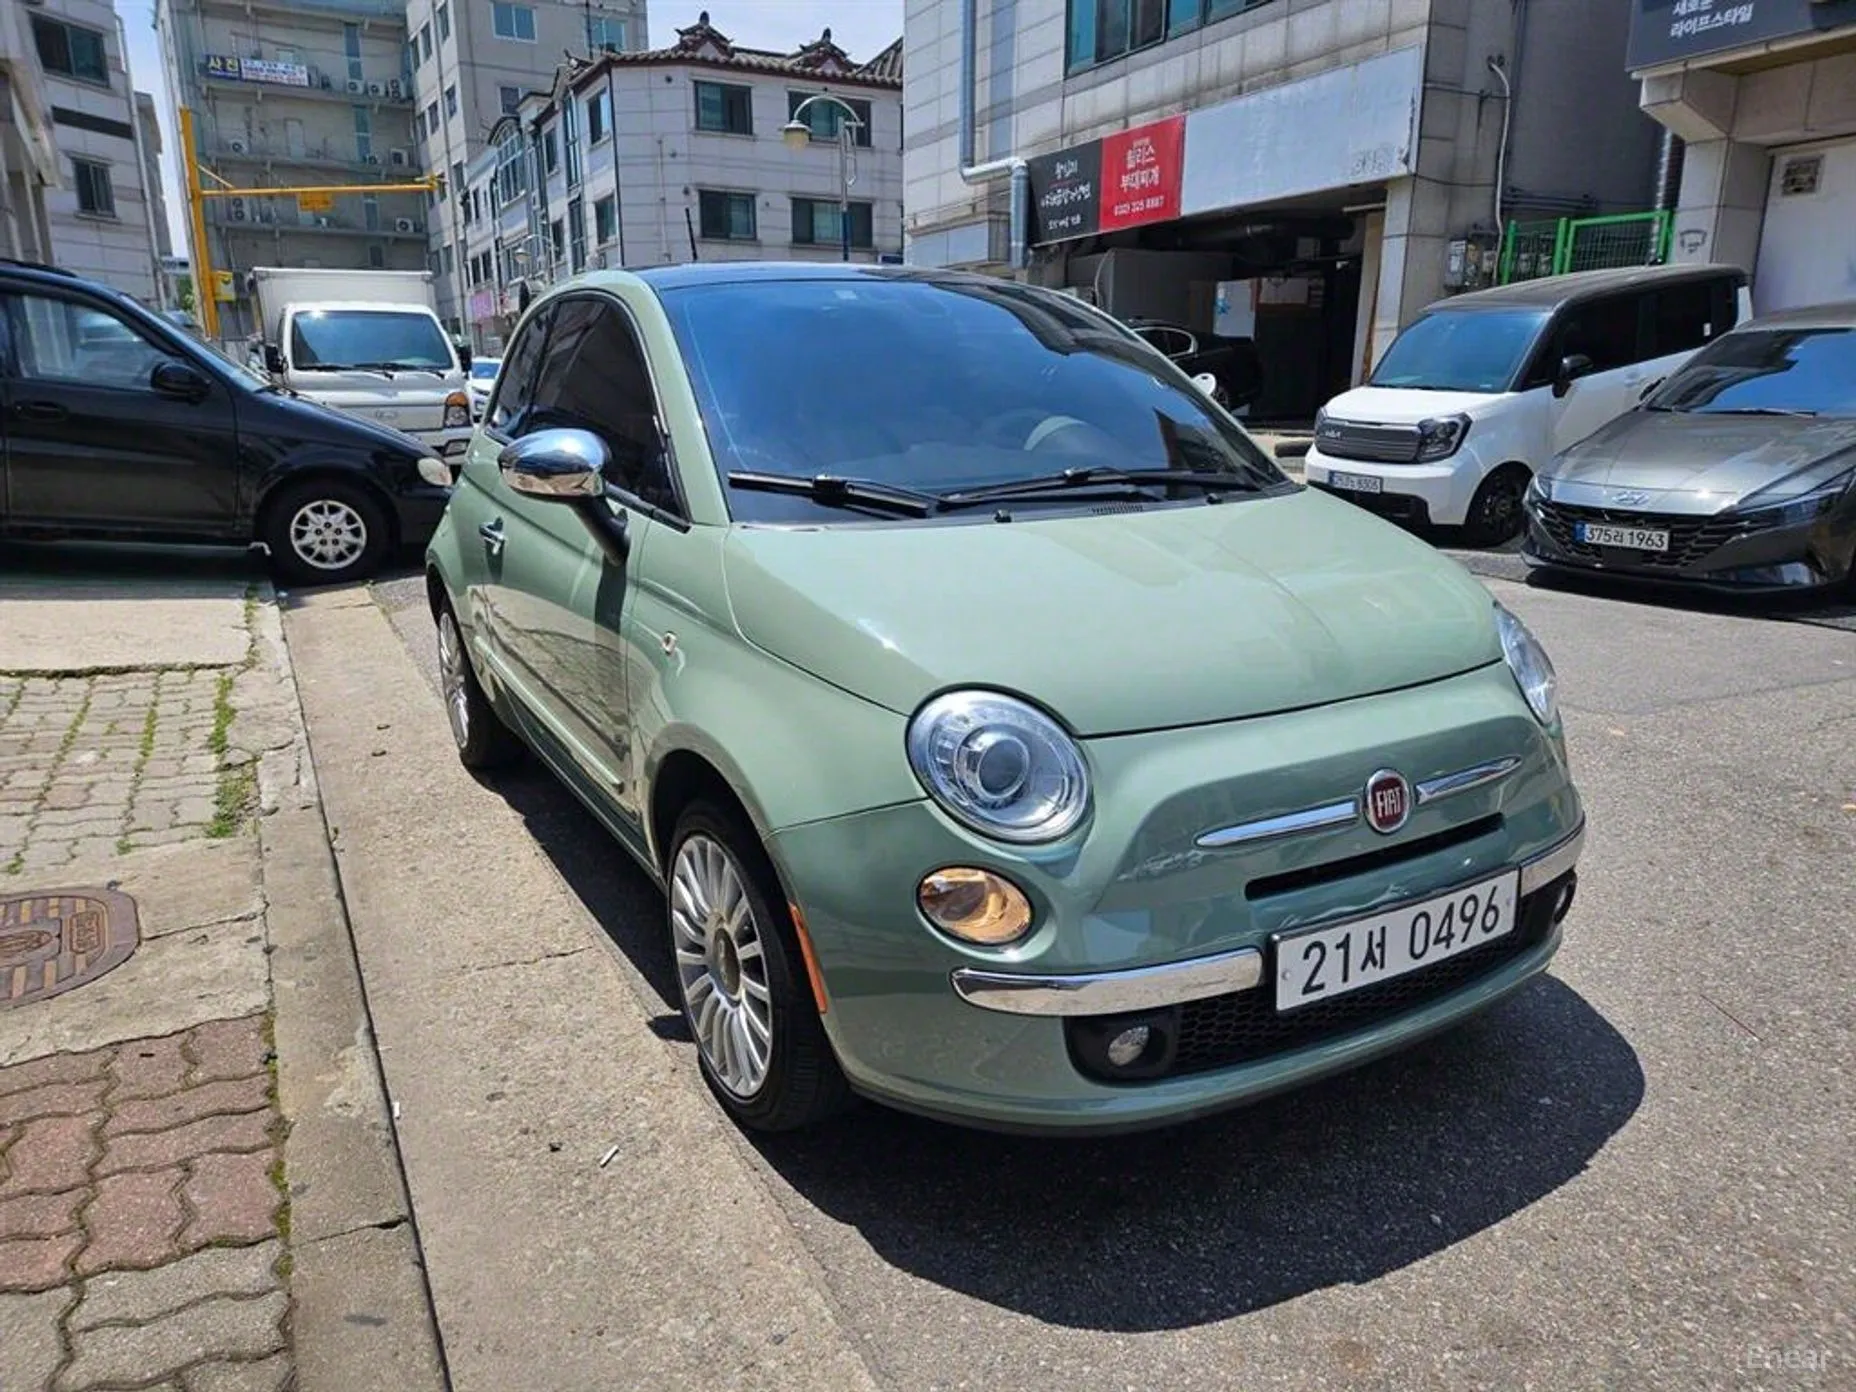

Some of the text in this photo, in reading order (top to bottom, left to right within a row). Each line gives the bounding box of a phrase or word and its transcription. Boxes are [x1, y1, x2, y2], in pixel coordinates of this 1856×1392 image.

[1670, 4, 1753, 37] 라이프스타일
[1628, 531, 1664, 548] 1963
[1301, 885, 1500, 996] 21서 0496
